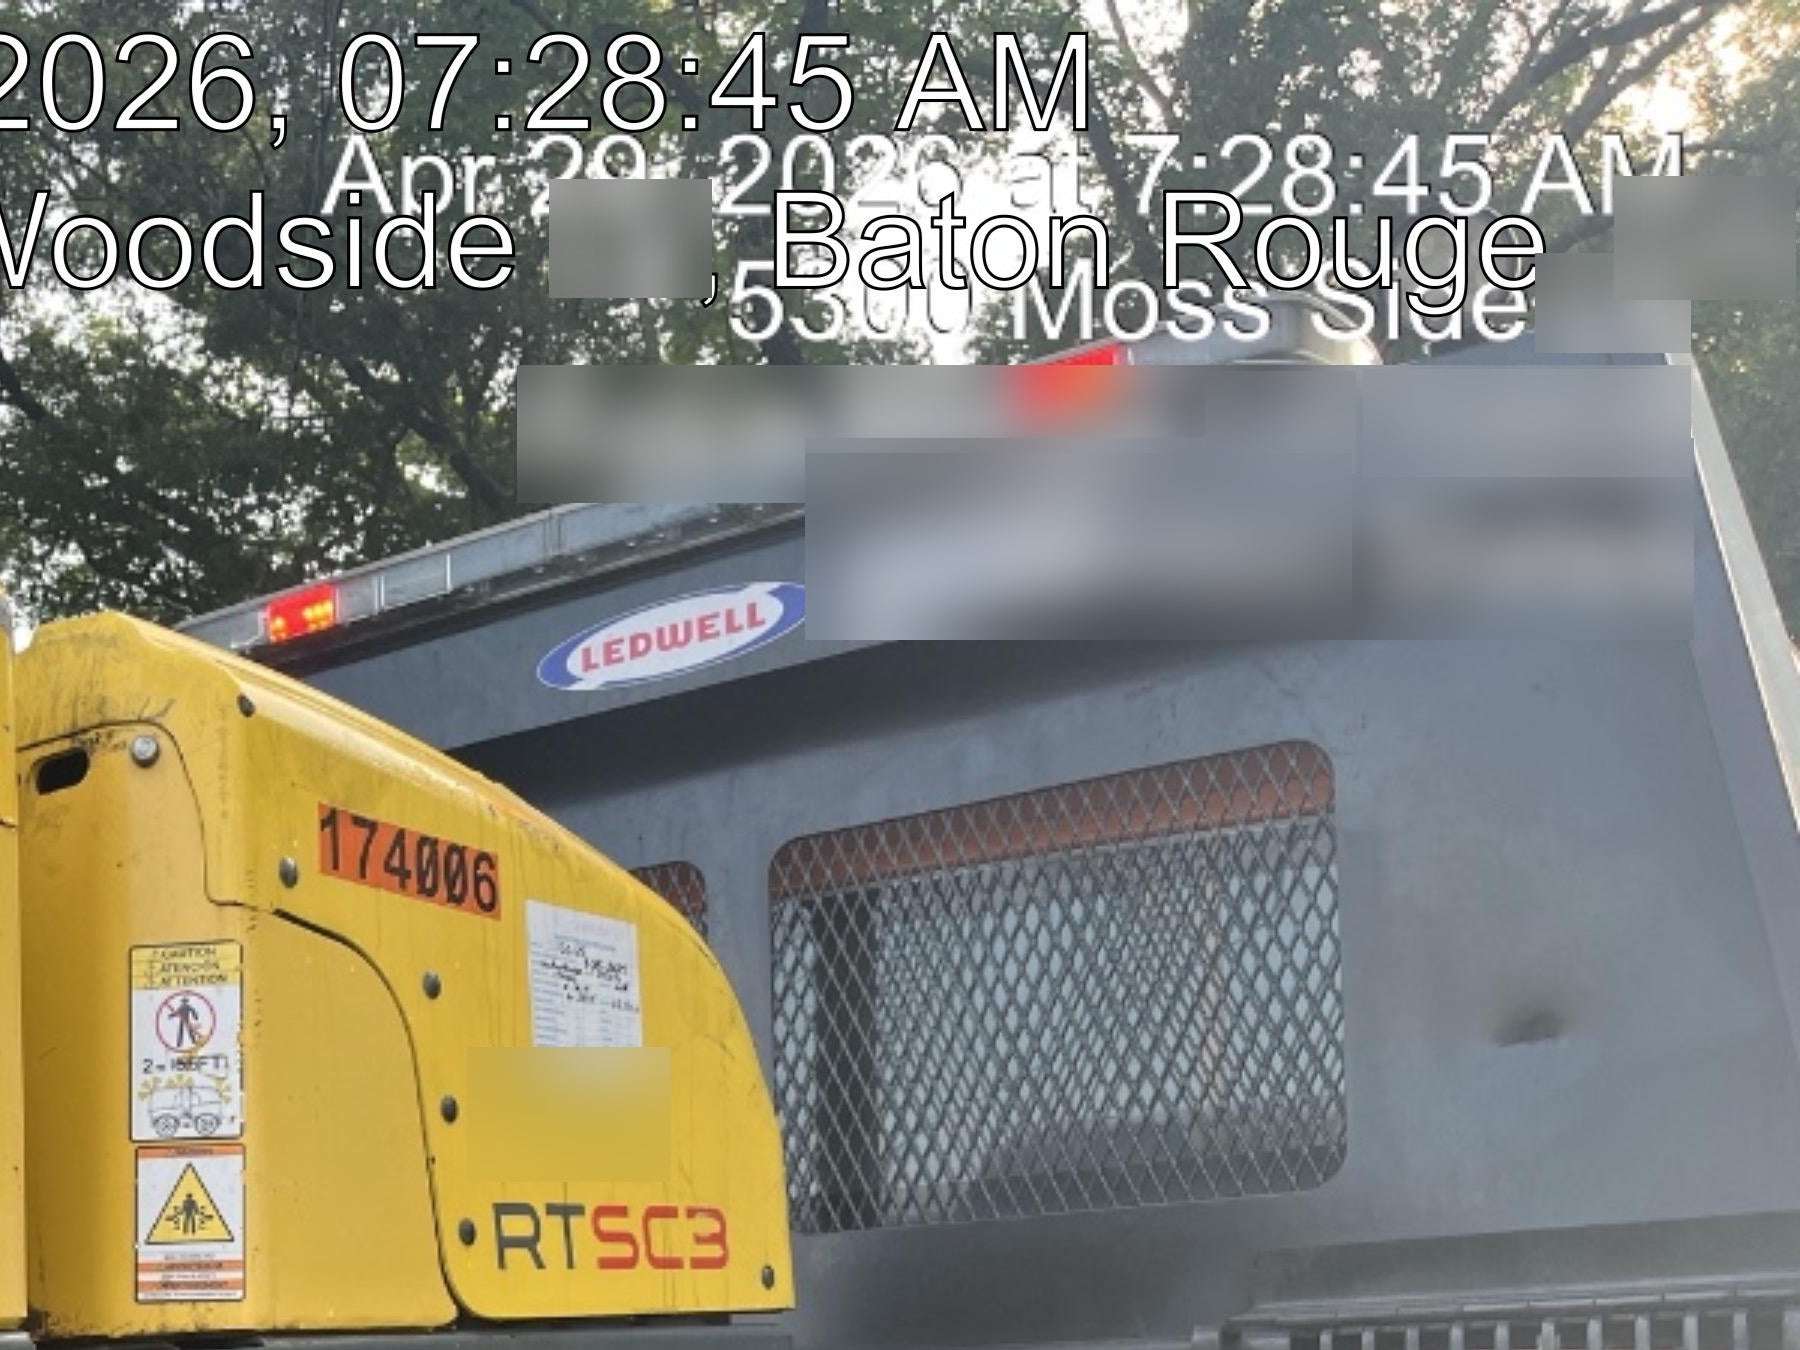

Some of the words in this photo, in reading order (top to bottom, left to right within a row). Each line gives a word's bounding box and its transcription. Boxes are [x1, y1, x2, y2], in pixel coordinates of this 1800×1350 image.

[579, 601, 767, 674] LEDWELL
[319, 806, 498, 913] 174006
[492, 1202, 730, 1270] RTSC3
